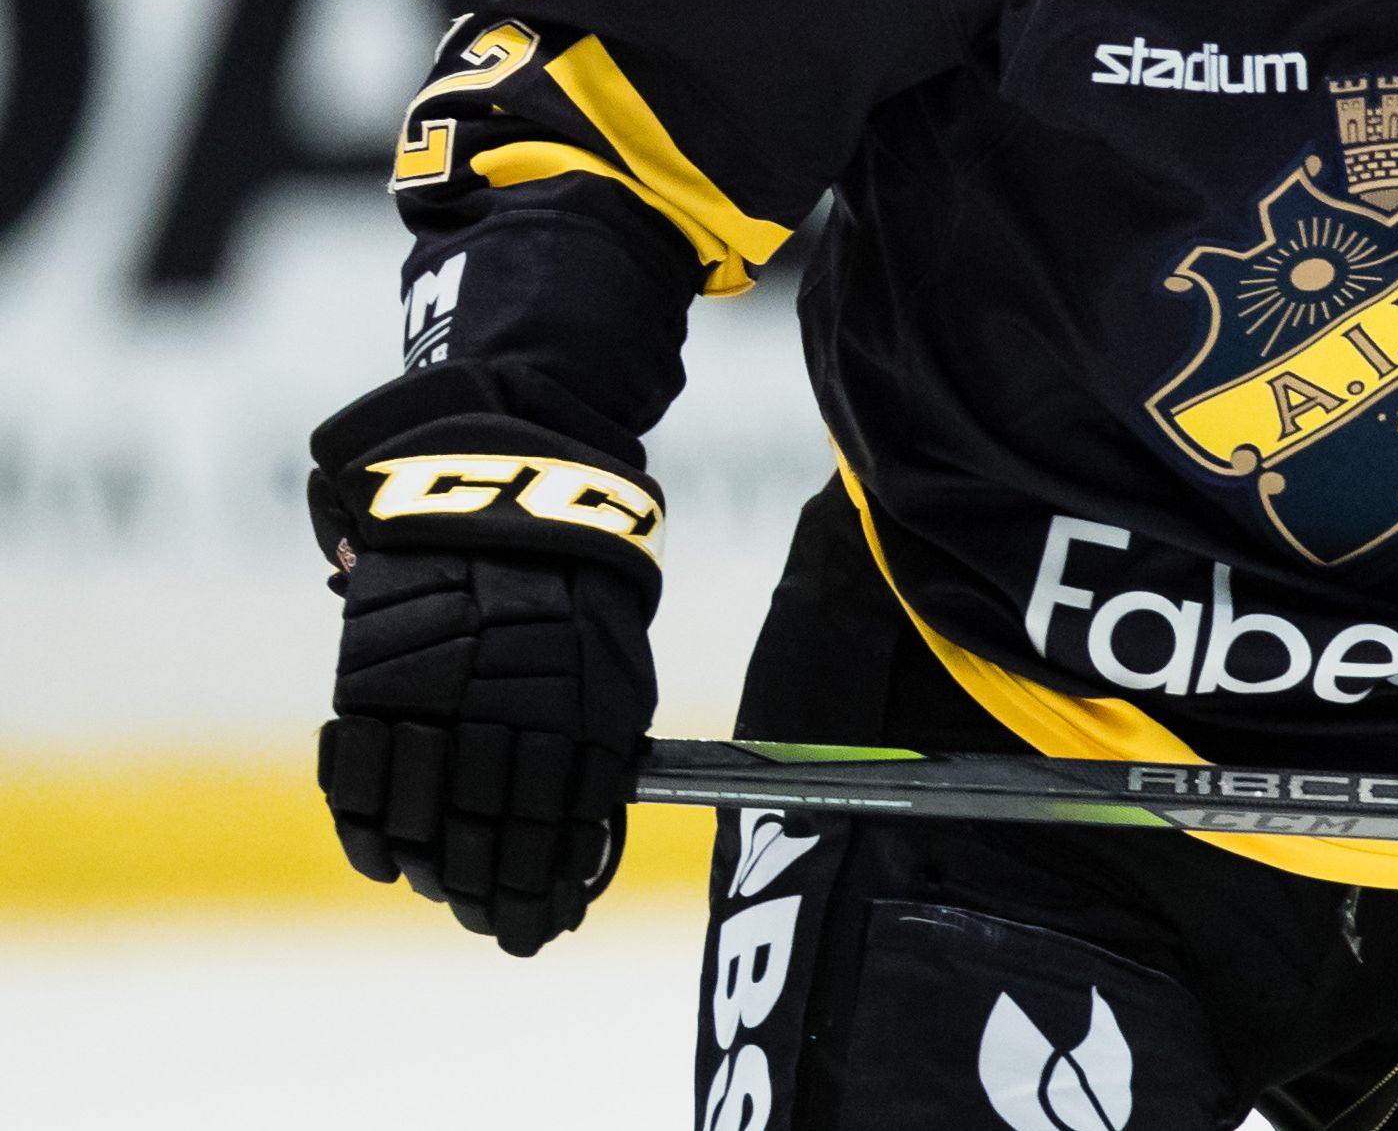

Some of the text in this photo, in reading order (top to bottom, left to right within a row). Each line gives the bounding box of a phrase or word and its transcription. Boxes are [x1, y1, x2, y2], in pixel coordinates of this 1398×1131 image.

[1092, 37, 1308, 93] stadium
[365, 453, 667, 570] CC
[1202, 809, 1360, 834] CCM
